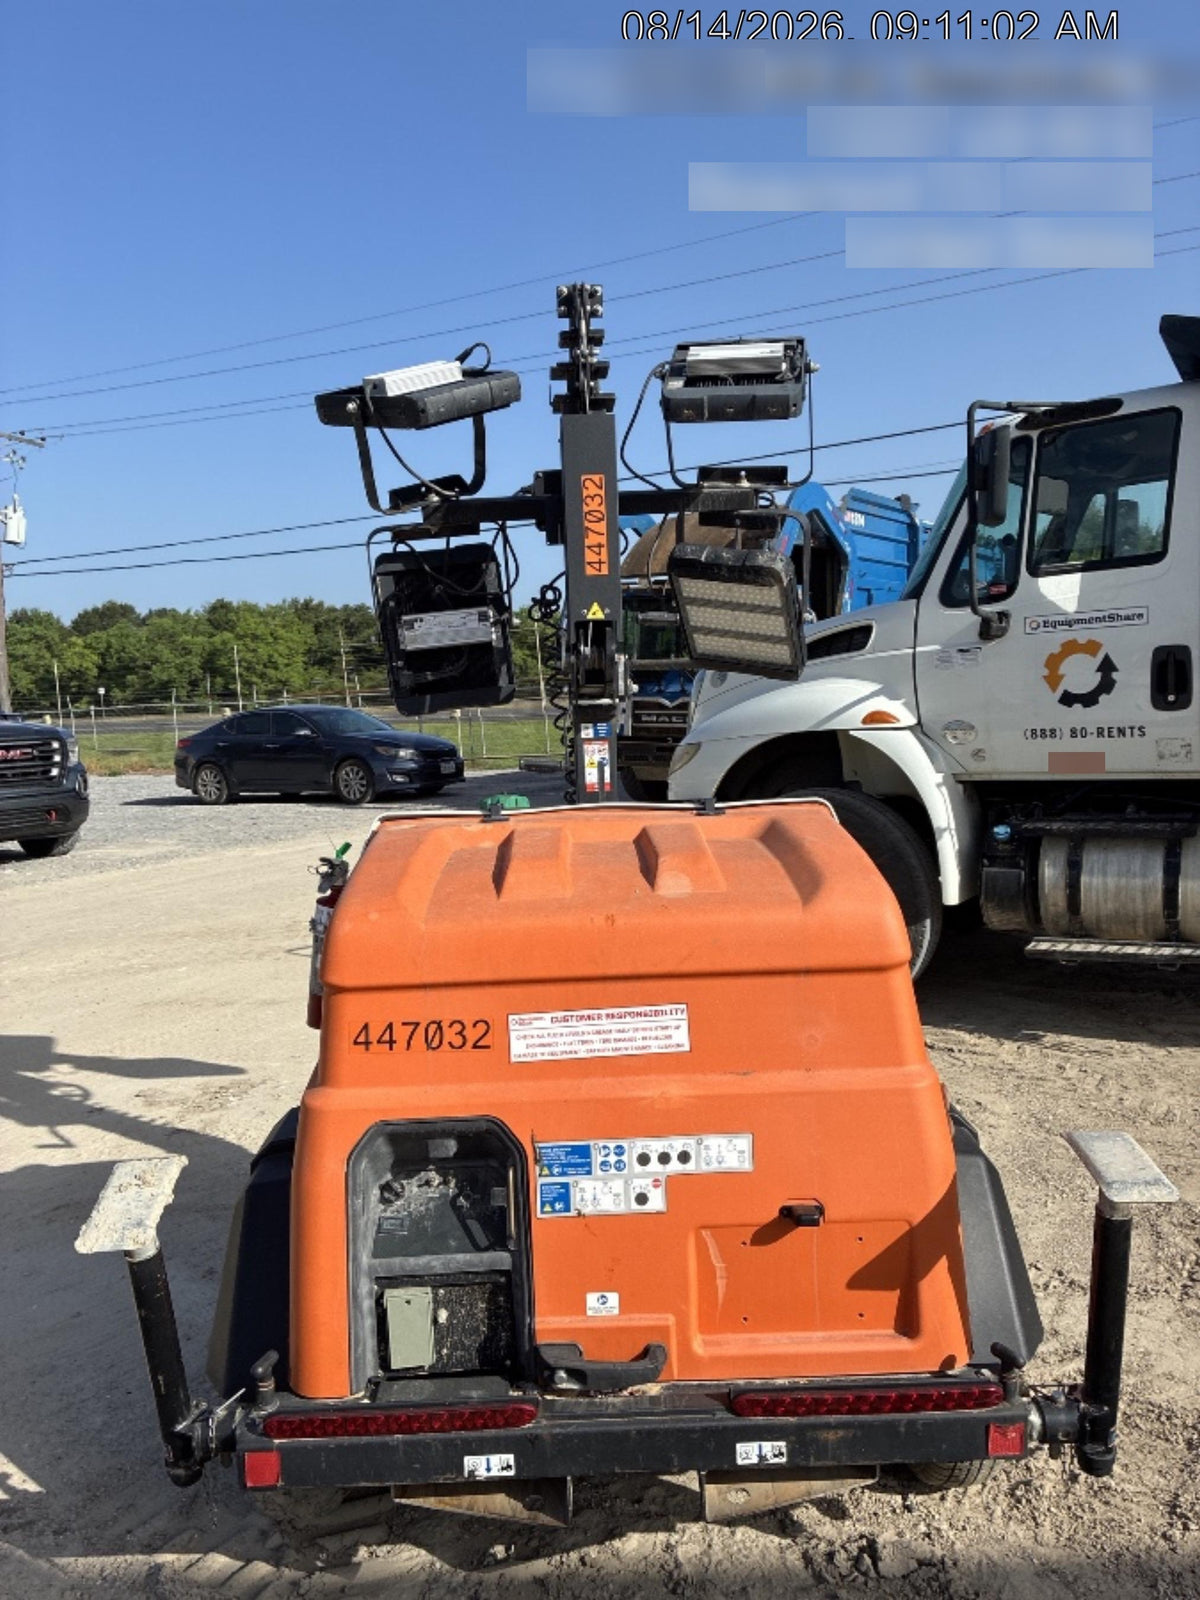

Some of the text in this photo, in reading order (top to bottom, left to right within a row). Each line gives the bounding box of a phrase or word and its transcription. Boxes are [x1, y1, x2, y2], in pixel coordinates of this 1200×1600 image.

[582, 476, 606, 573] 447032
[1042, 612, 1144, 629] EquipmentShare
[1024, 725, 1147, 740] (888) 80-RENTS
[550, 1013, 603, 1024] CUSTOMER
[605, 1007, 685, 1020] RESPONSIBILITY
[353, 1019, 491, 1051] 447032
